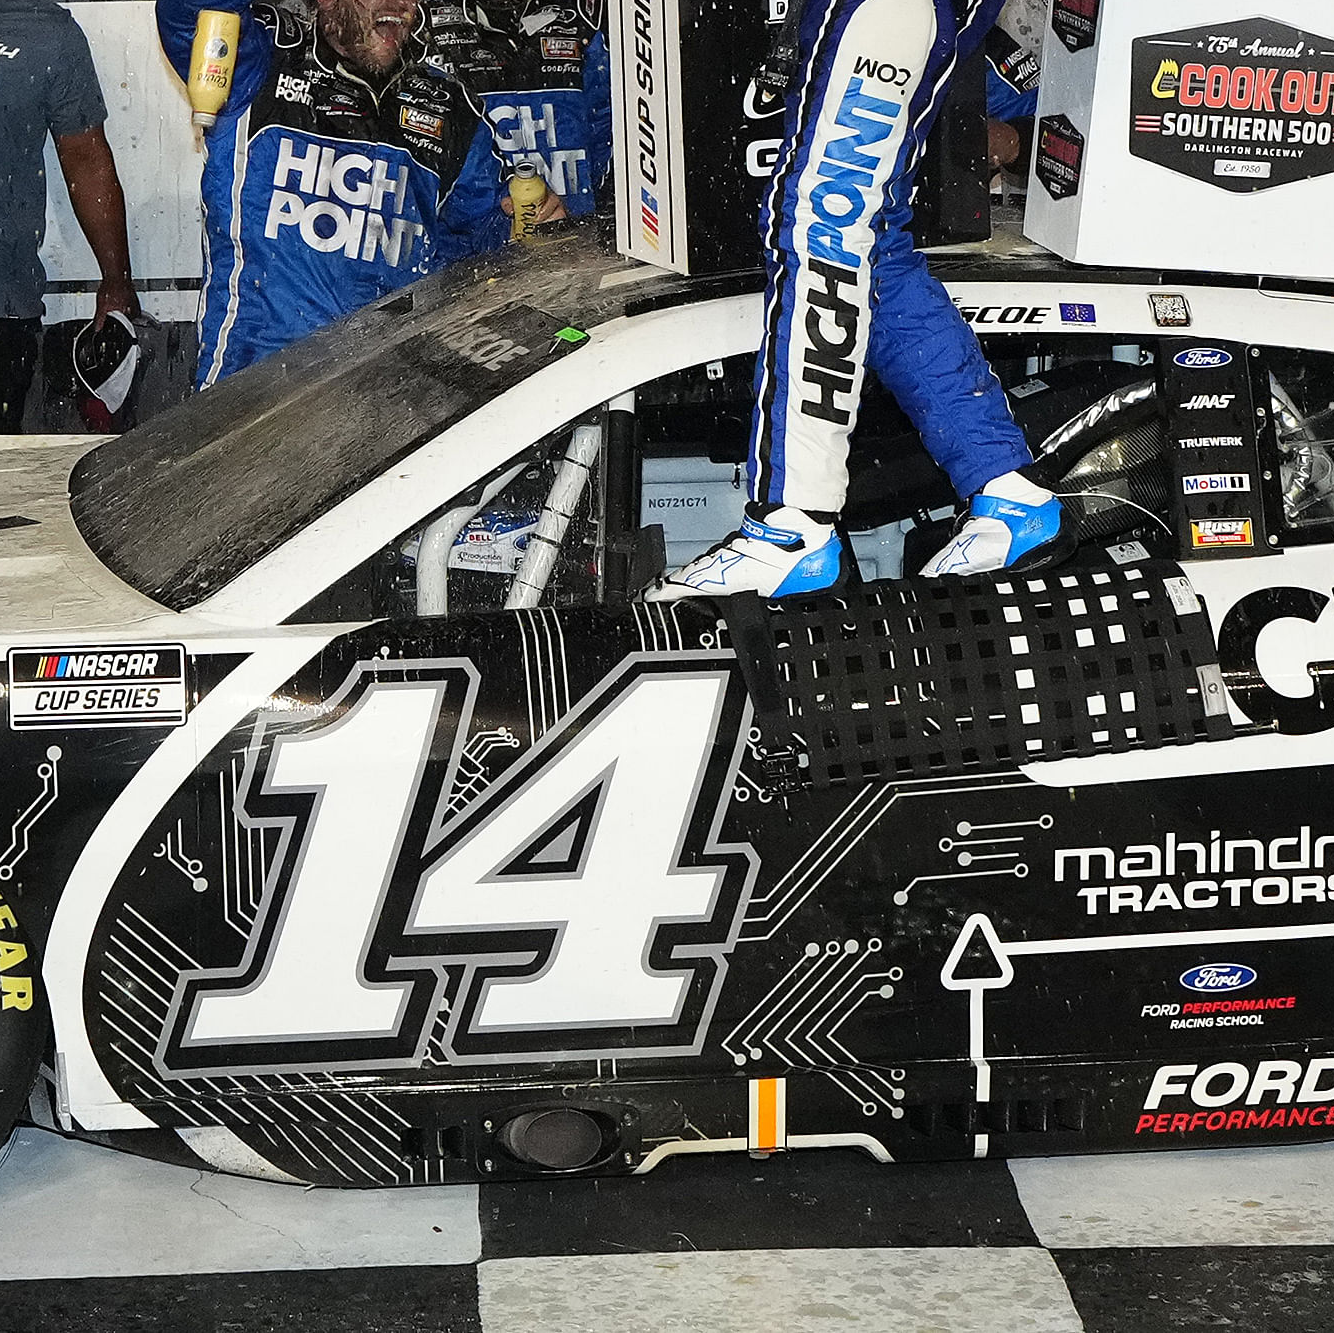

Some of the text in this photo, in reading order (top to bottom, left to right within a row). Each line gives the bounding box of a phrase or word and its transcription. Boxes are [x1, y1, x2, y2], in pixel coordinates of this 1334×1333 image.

[1206, 35, 1305, 59] 75th Annual
[278, 73, 311, 91] HIGH
[1179, 63, 1279, 112] COOK
[275, 86, 314, 106] POINT
[493, 104, 559, 151] GH
[1161, 112, 1332, 146] SOUTHERN 500
[638, 105, 659, 185] CUP
[1184, 143, 1304, 159] DARLINGTON RACEWAY
[273, 138, 409, 214] HIGH
[1240, 163, 1261, 174] 1950
[264, 189, 424, 267] POINT
[961, 306, 1052, 324] SCOE
[1185, 350, 1221, 366] Ford
[1180, 394, 1236, 410] HAAS
[1178, 436, 1244, 449] TRUEWERK
[1185, 476, 1228, 492] Mobil
[648, 496, 708, 509] NG721C71
[468, 533, 492, 542] BELL
[1198, 520, 1245, 536] RUSH
[64, 651, 158, 678] NASCAR
[34, 684, 160, 711] CUP SERIES
[170, 662, 743, 1058] 14
[1194, 966, 1243, 988] Ford
[1140, 996, 1297, 1018] FORD PERFORMANCE
[1170, 1014, 1265, 1030] RACING SCHOOL
